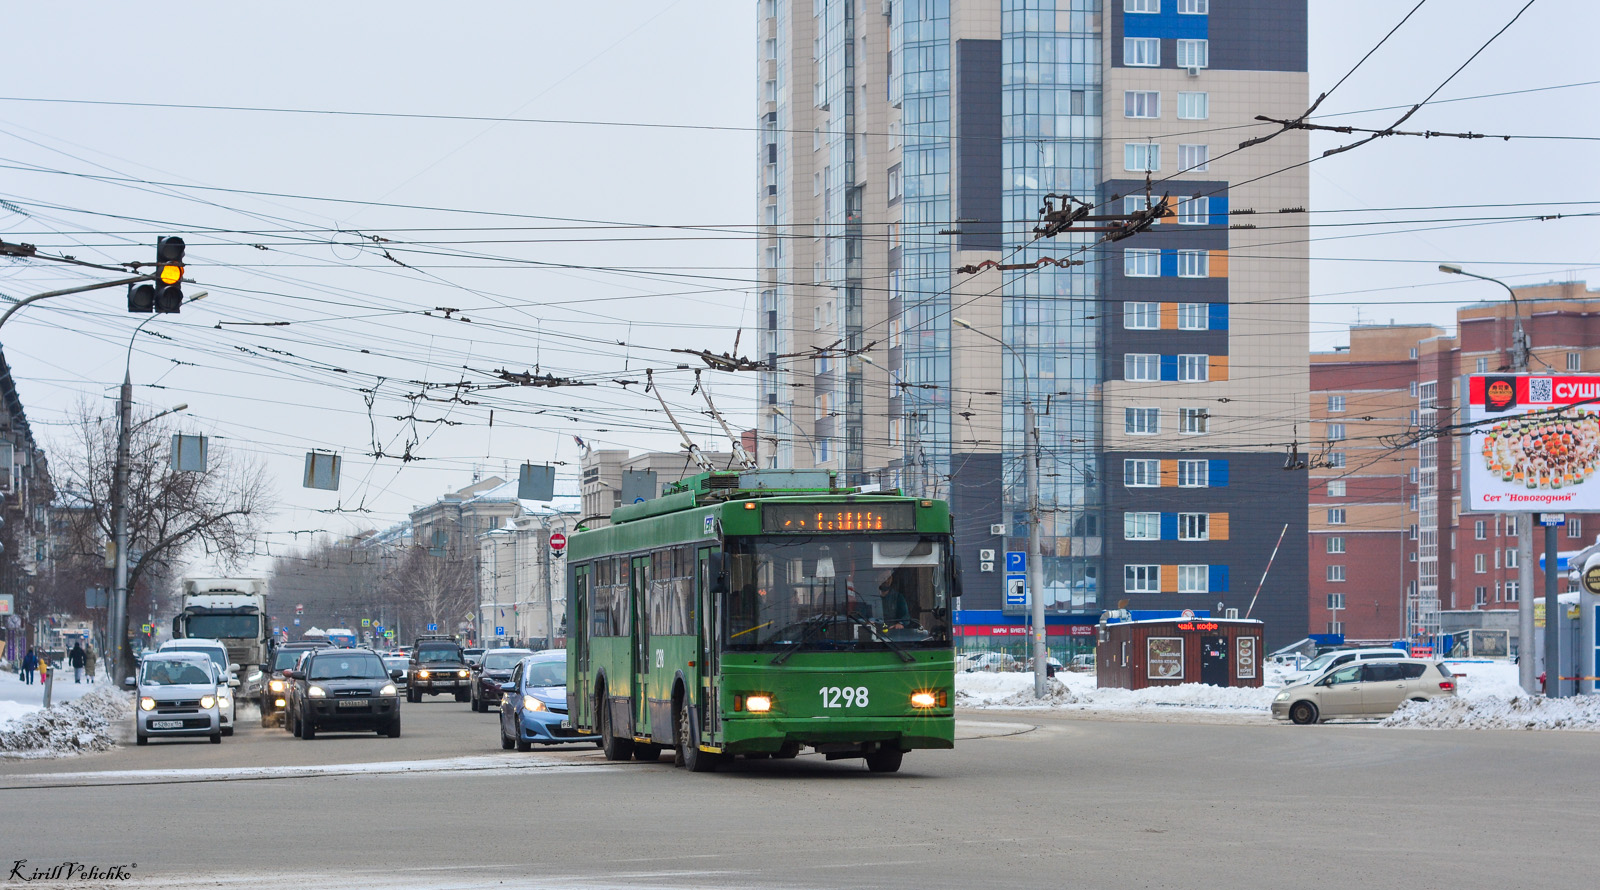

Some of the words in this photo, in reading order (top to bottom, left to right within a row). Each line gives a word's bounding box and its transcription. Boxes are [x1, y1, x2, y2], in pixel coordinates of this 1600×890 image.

[1483, 494, 1502, 502] Сет
[1504, 493, 1577, 504] "Новогодний"
[1177, 622, 1196, 631] чай,
[1196, 622, 1218, 631] кофе
[655, 648, 665, 668] 1298
[819, 686, 869, 708] 1298
